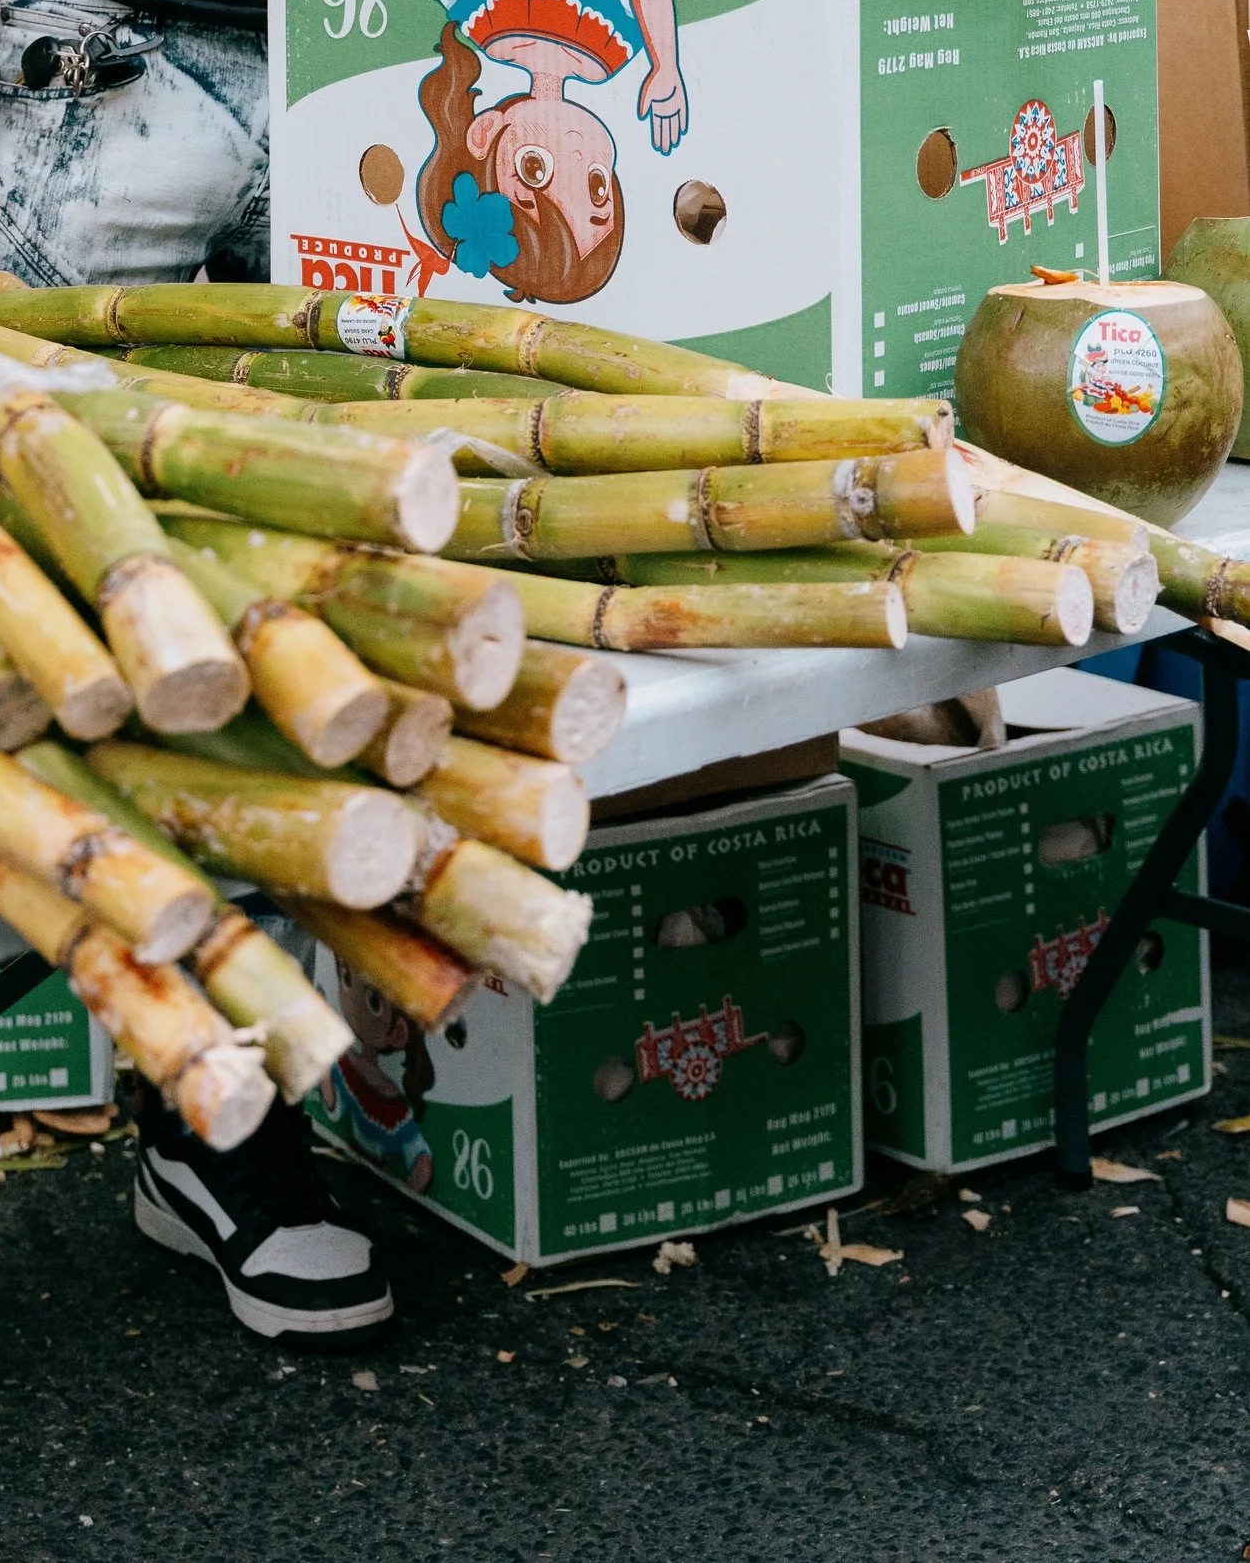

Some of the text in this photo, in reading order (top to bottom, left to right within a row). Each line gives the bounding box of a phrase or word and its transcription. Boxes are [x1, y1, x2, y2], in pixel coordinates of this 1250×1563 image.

[883, 13, 955, 36] Net Weight:
[1101, 19, 1116, 29] Costa
[1076, 35, 1105, 50] ARCSAM
[1107, 32, 1117, 43] by:
[1118, 27, 1147, 43] Exported
[1031, 44, 1047, 56] Rica
[1046, 40, 1066, 54] Costa
[1067, 40, 1076, 50] de
[879, 49, 960, 75] Reg Mag 2179
[301, 239, 397, 263] PRODUCE
[897, 293, 966, 316] Camote/Sweet potato
[362, 337, 378, 345] PLU
[914, 324, 966, 345] Chayote/Squash
[1098, 322, 1142, 343] Tica
[1136, 349, 1157, 358] 4260
[961, 738, 1173, 800] PRODUCT OF COSTA RICA
[670, 844, 698, 863] OF
[707, 830, 767, 856] COSTA
[775, 819, 822, 842] RICA
[452, 1129, 495, 1201] 86
